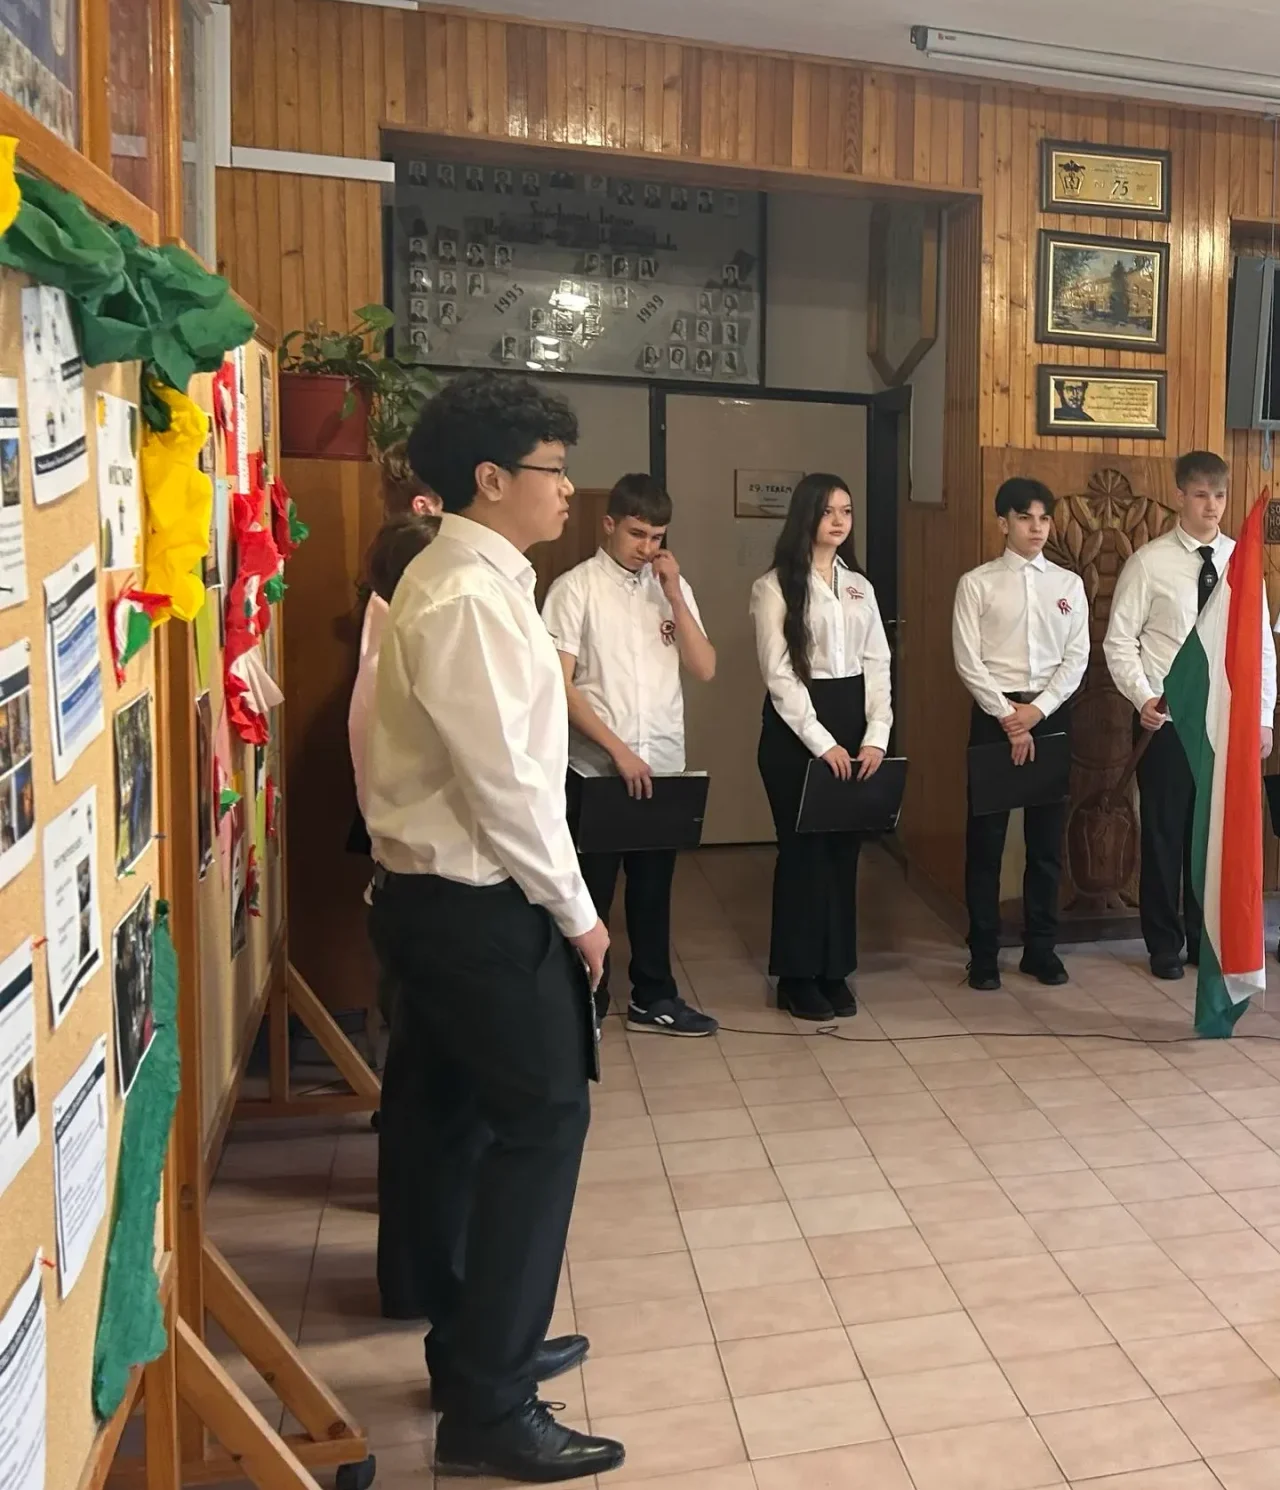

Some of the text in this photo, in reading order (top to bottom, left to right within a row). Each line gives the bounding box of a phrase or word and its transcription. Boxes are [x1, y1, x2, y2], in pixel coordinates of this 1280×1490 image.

[1111, 180, 1129, 196] 75
[494, 283, 525, 315] 1995
[636, 294, 665, 324] 1999
